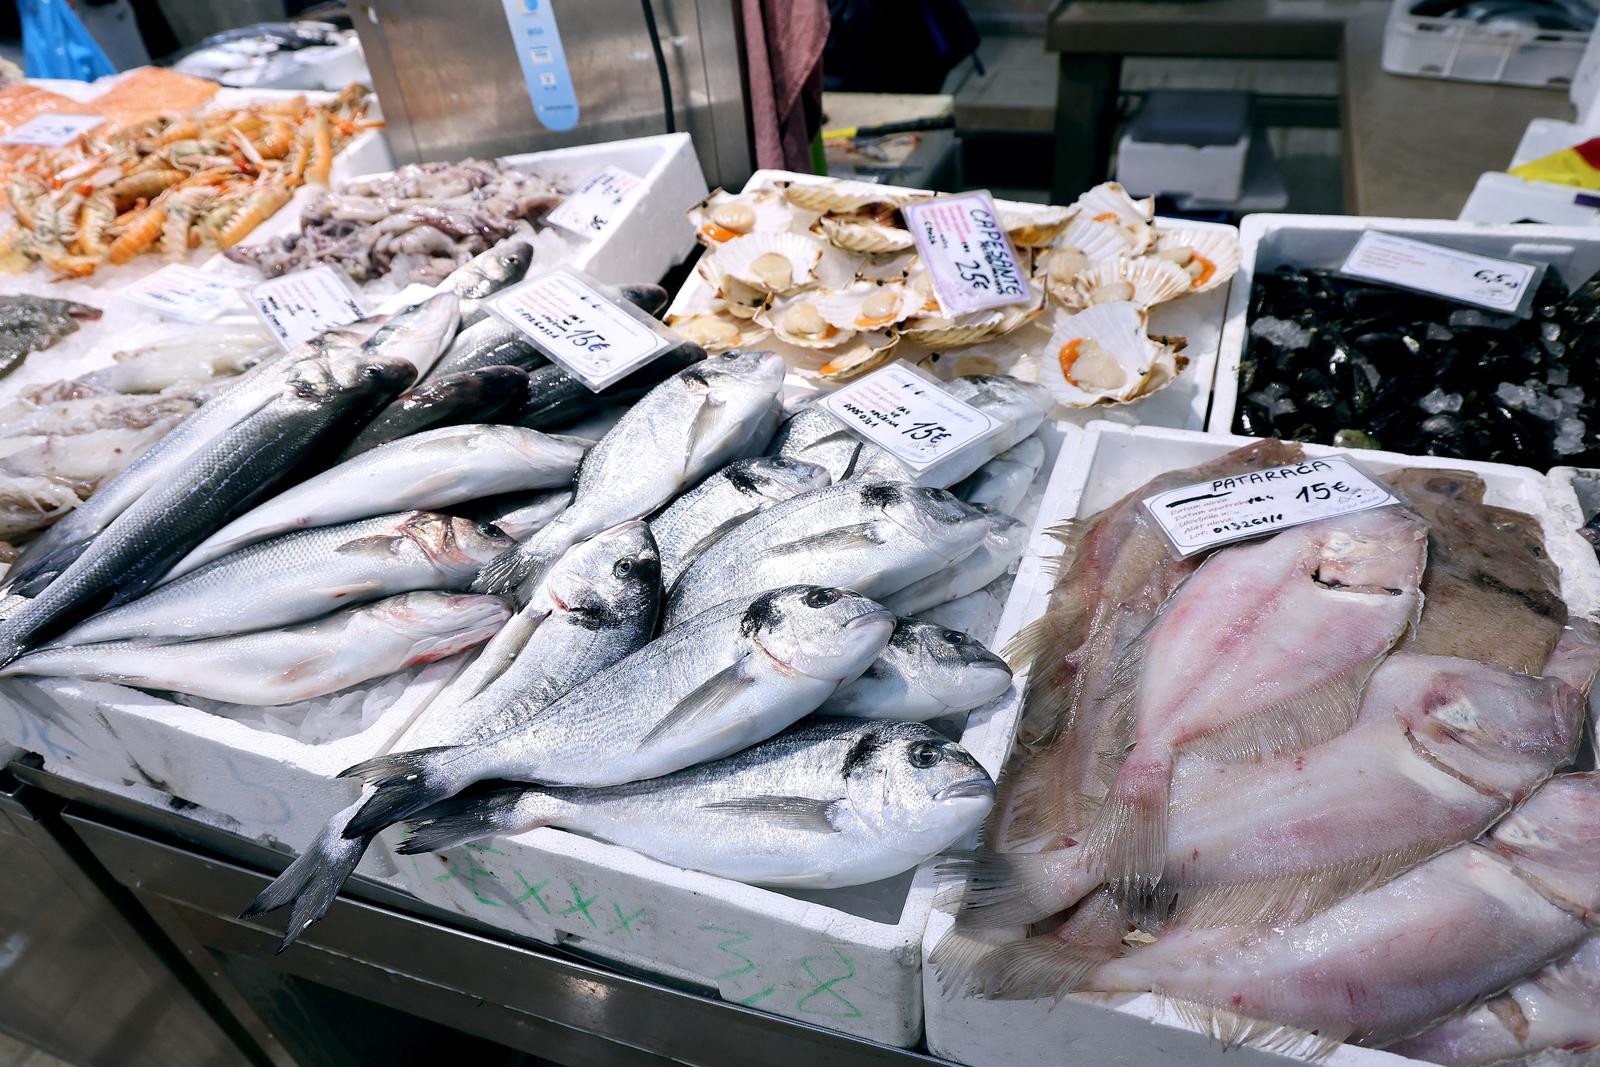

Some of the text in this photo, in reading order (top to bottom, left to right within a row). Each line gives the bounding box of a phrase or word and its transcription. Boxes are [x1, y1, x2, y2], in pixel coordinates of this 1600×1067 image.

[970, 209, 1024, 295] CAPESANTE
[955, 260, 991, 290] 25€
[566, 329, 611, 352] 15€
[901, 422, 952, 443] 15€
[1212, 460, 1332, 492] PATARAČA
[1296, 480, 1350, 503] 15€
